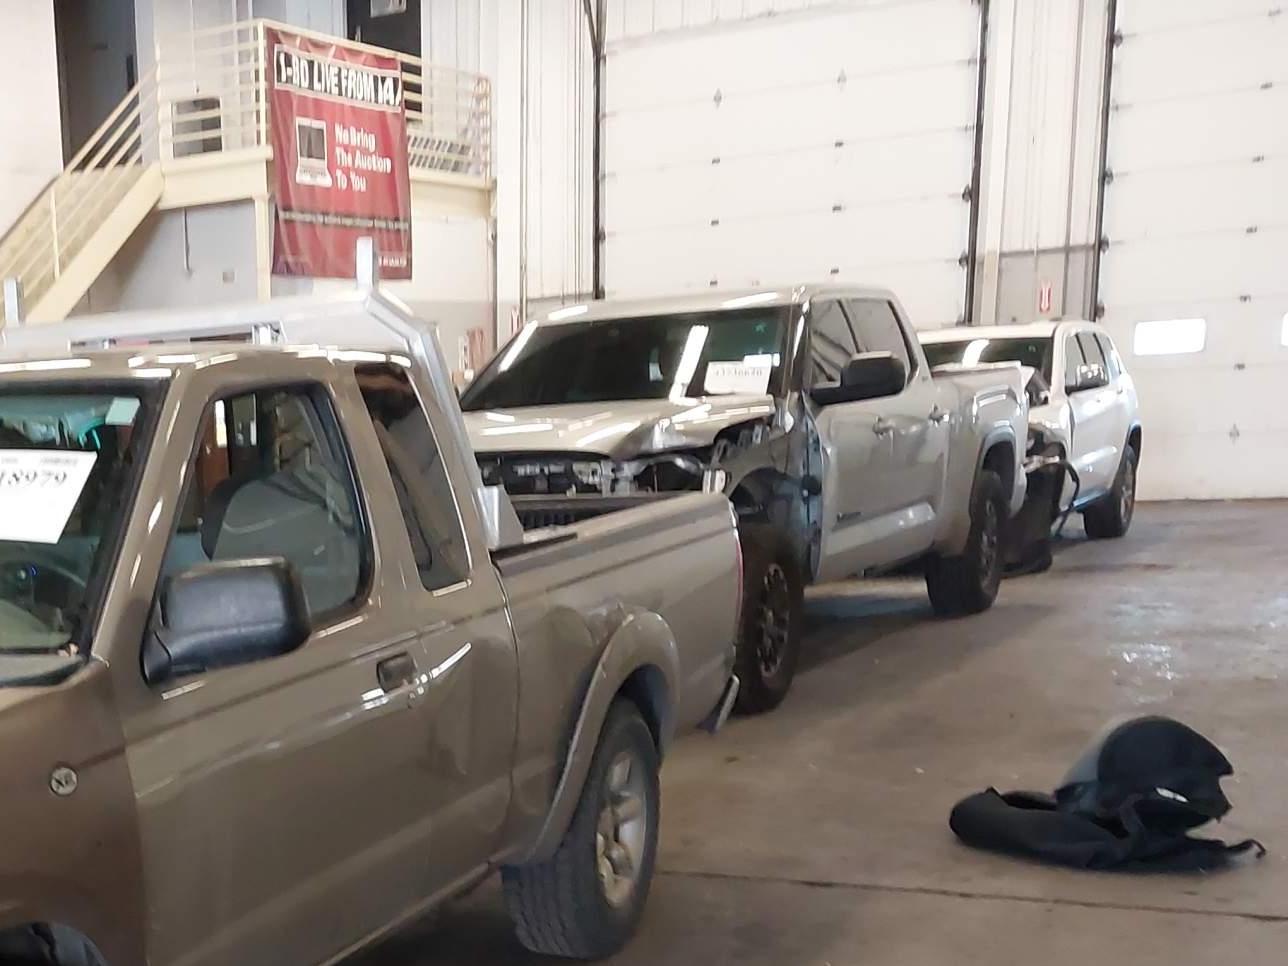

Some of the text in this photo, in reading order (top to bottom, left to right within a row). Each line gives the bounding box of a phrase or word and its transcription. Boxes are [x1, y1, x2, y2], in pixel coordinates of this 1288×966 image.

[313, 59, 339, 96] LIVE
[340, 65, 375, 103] FROM
[350, 126, 376, 153] Bring
[335, 146, 392, 174] The Auction
[335, 168, 367, 193] To You
